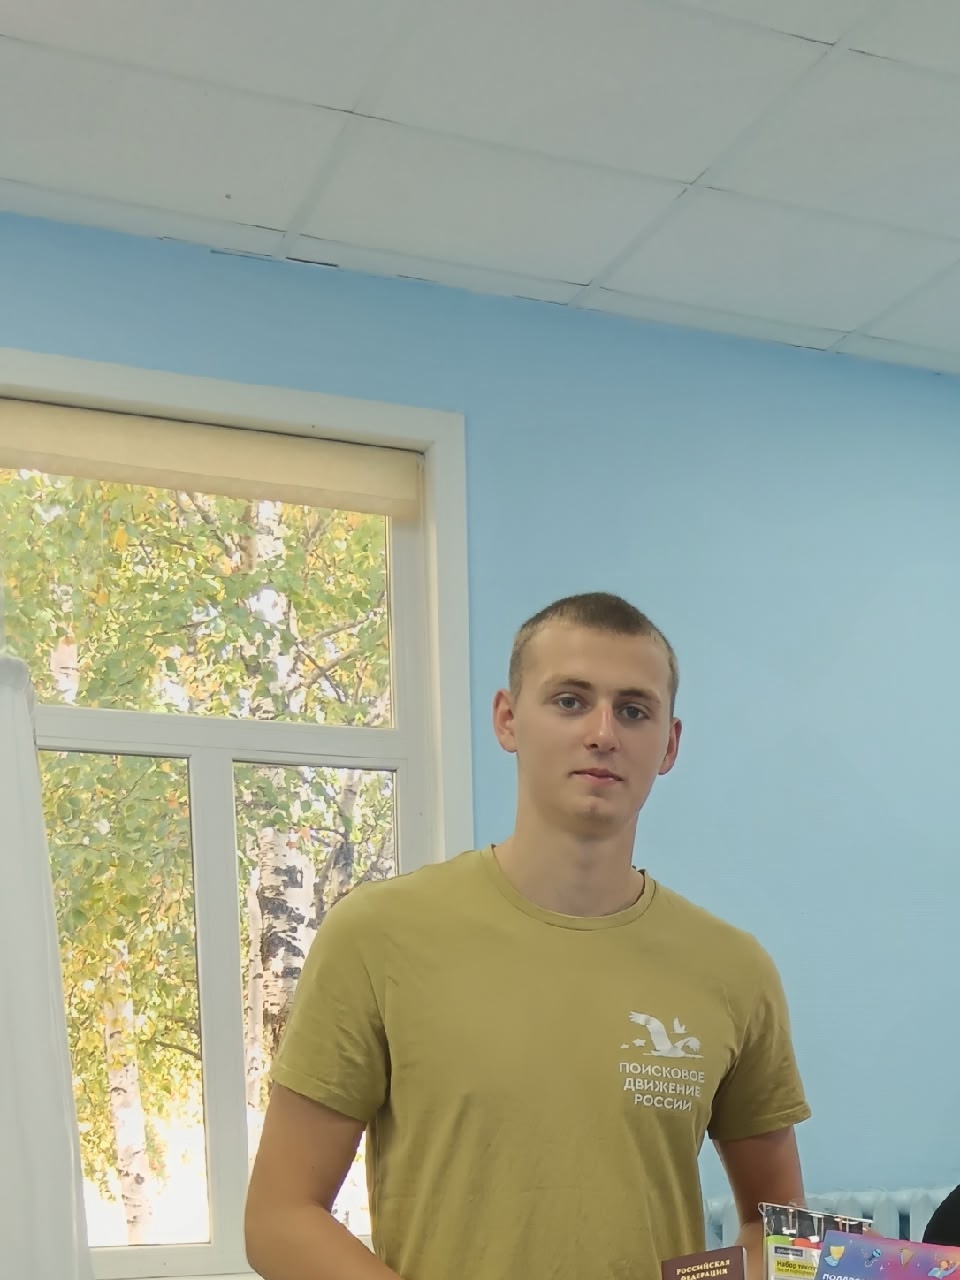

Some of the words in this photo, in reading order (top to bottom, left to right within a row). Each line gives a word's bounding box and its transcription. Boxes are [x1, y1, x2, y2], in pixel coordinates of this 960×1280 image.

[619, 1062, 705, 1083] ПОИСКОВОЕ
[623, 1077, 701, 1097] ДВИЖЕНИЕ
[634, 1094, 692, 1111] РОССИИ
[676, 1259, 731, 1276] РОССИЙСКАЯ
[776, 1260, 797, 1270] Набор
